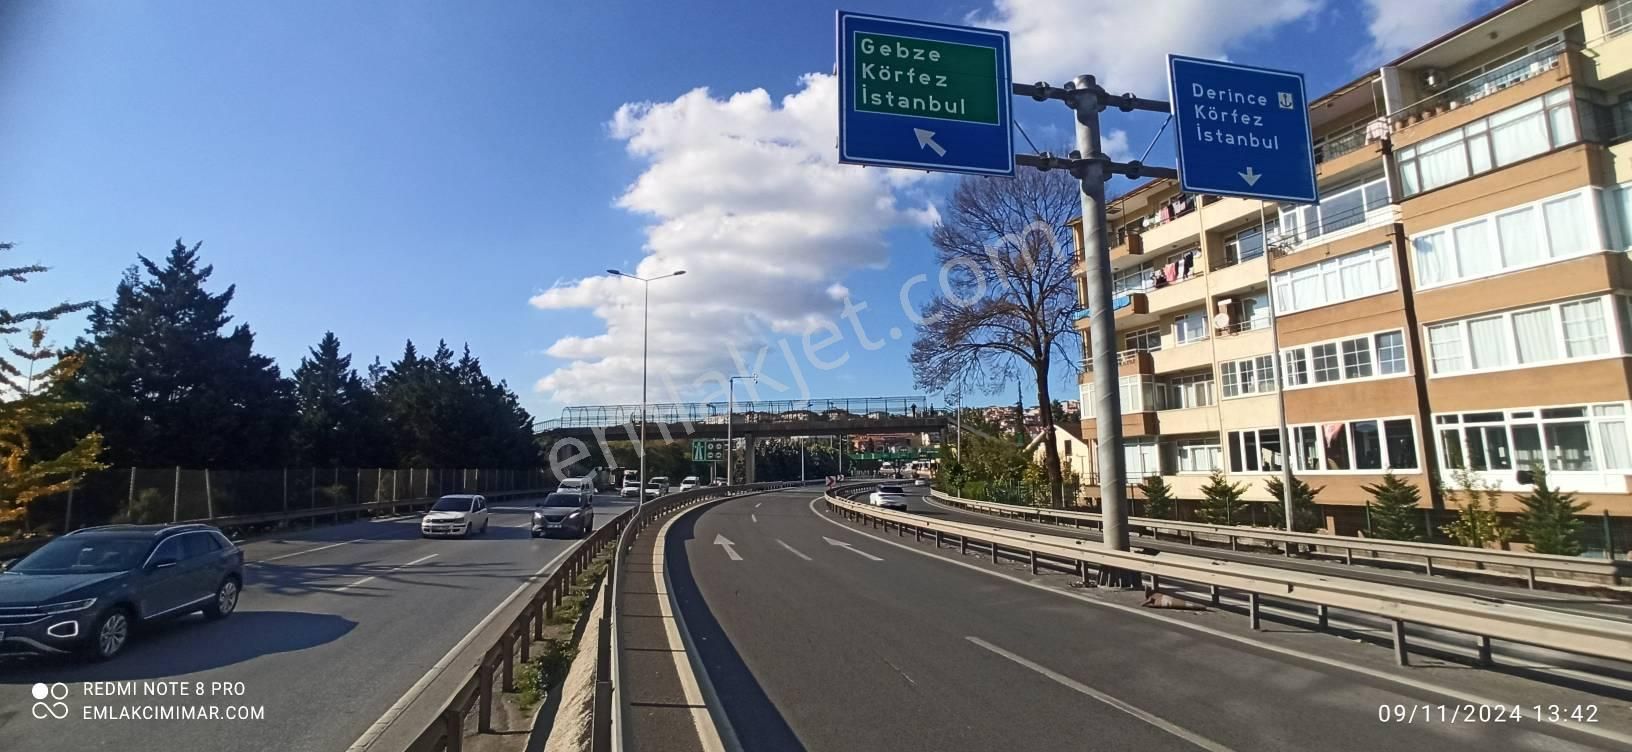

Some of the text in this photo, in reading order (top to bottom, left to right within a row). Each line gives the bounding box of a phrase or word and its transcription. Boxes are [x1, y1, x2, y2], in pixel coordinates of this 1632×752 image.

[861, 38, 941, 62] Gebze
[862, 64, 948, 87] Körfez
[862, 84, 966, 115] İstanbul
[1192, 83, 1268, 106] Derince
[1194, 105, 1264, 126] Körfez
[1197, 124, 1279, 150] İstanbul
